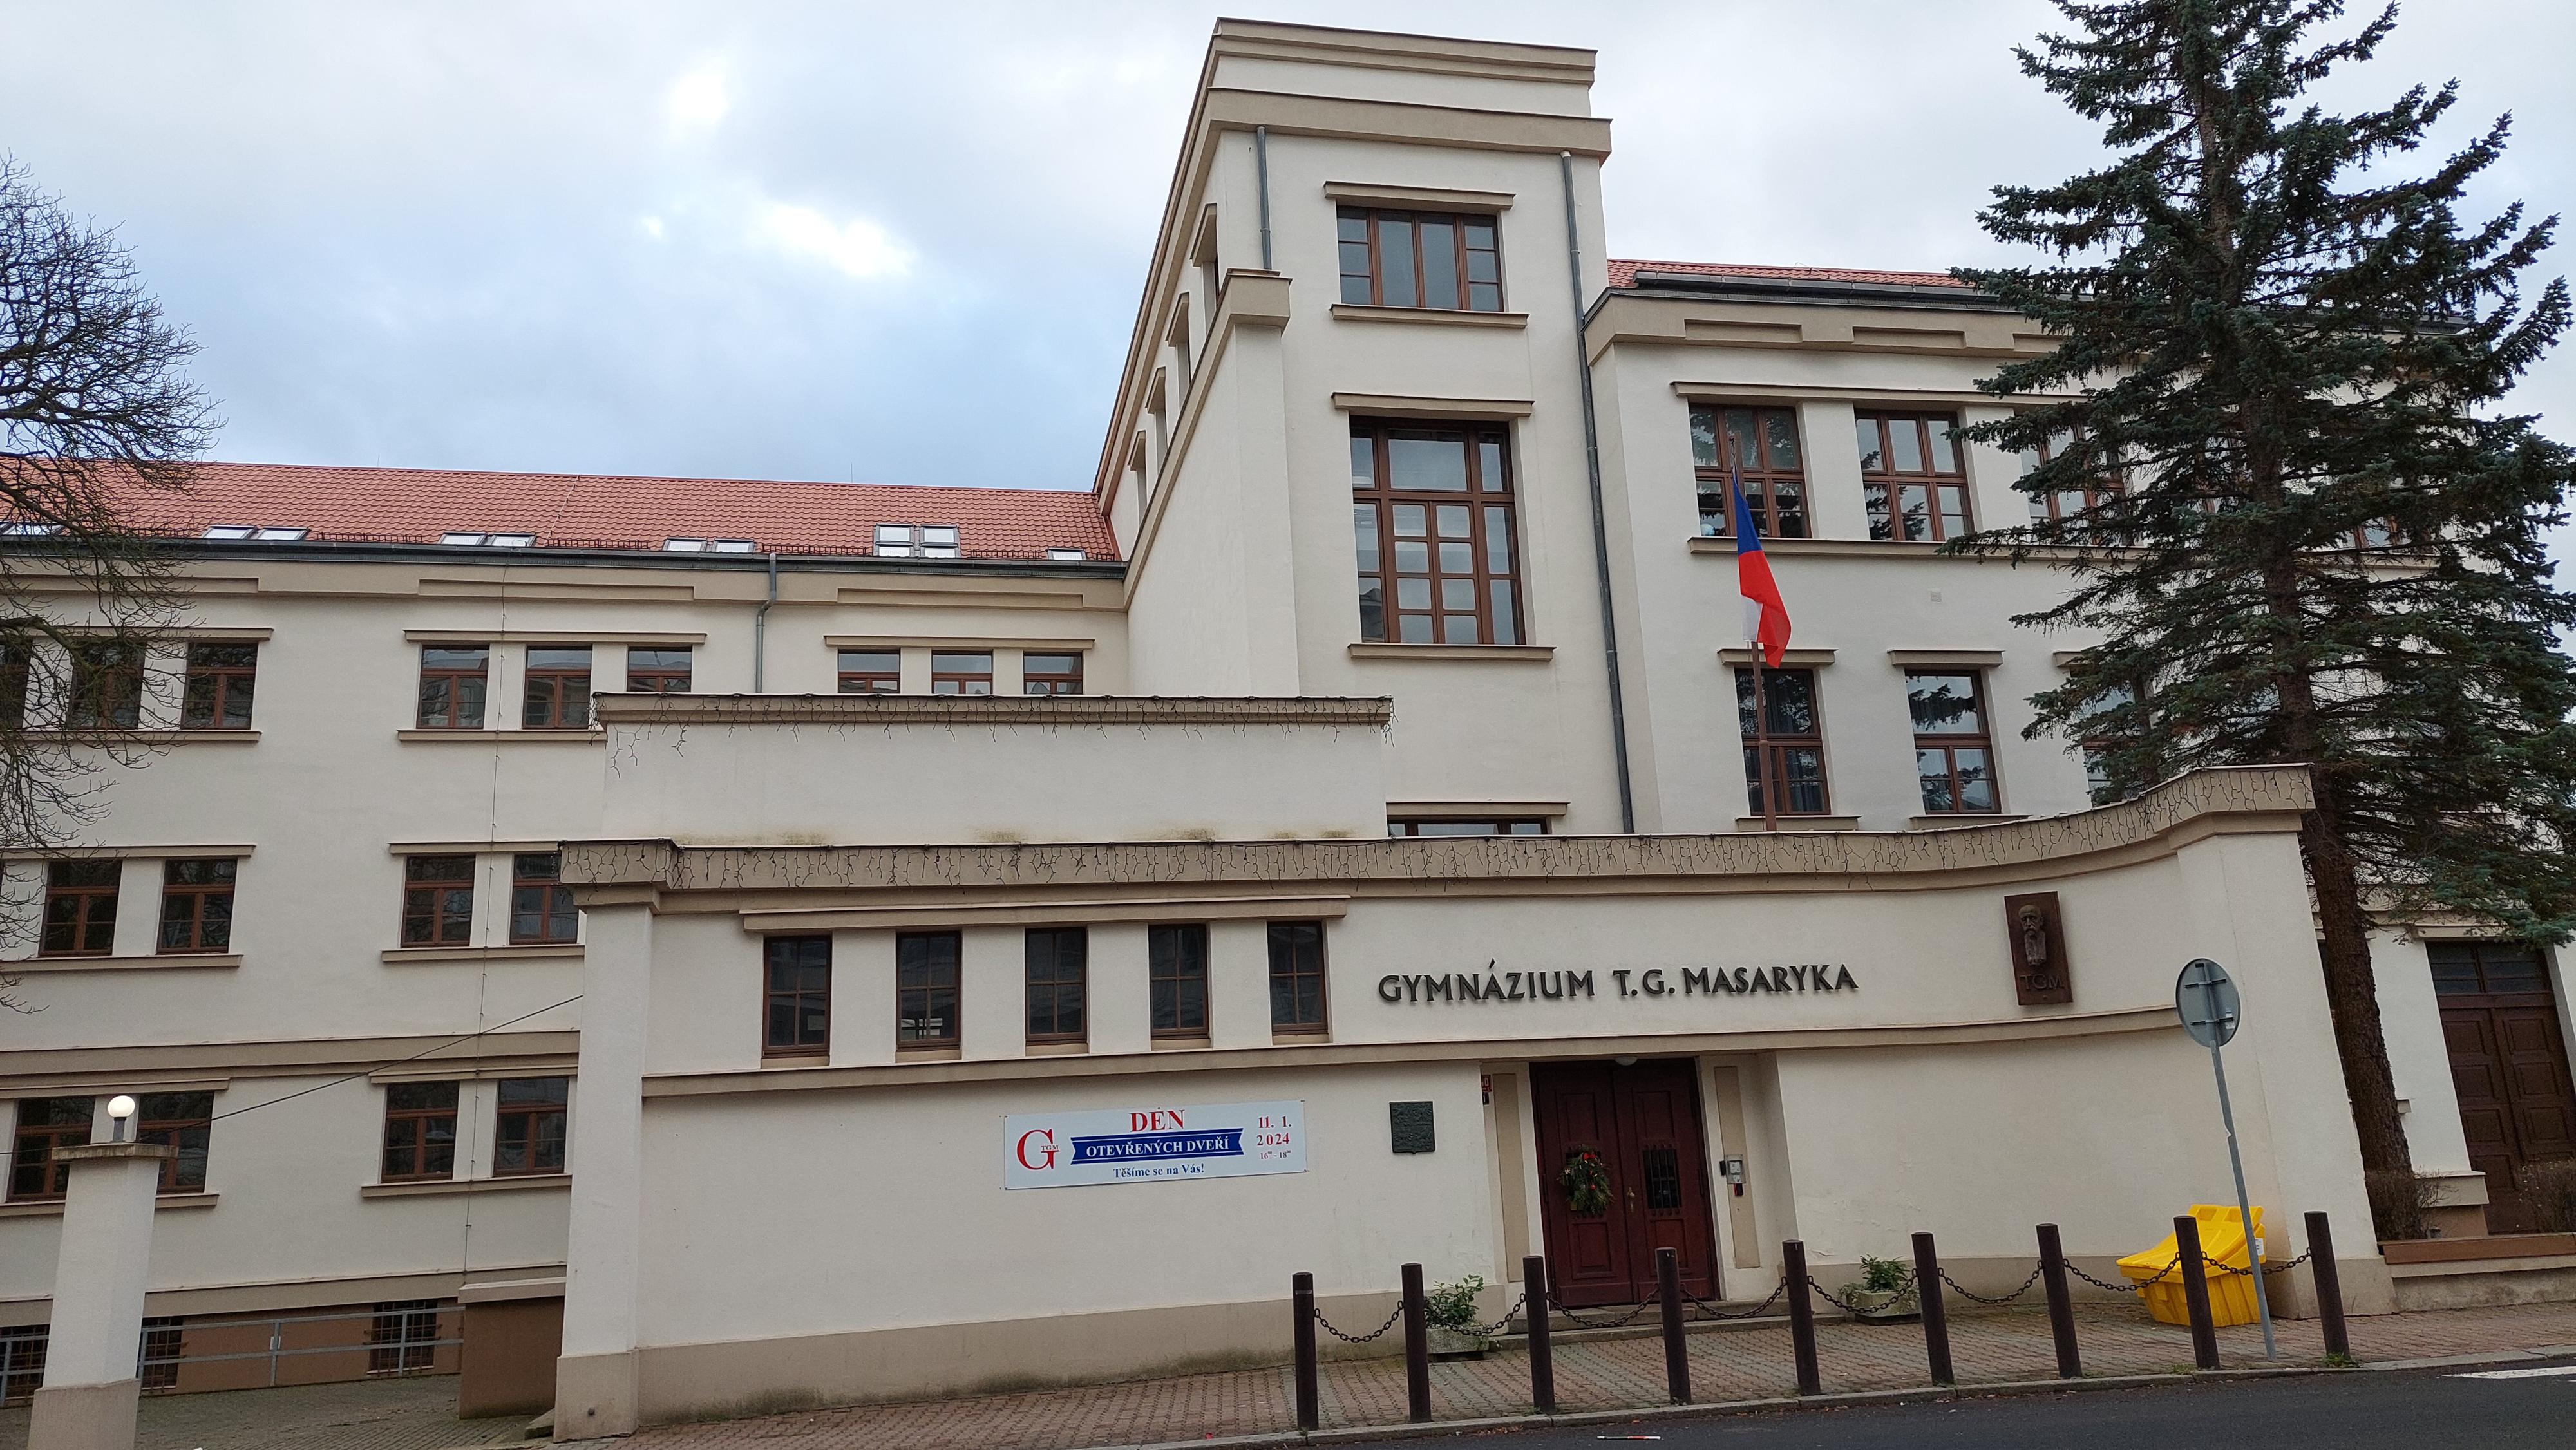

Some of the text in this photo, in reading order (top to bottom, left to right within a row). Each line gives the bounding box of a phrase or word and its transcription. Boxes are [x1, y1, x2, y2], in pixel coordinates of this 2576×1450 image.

[1378, 958, 1595, 1004] GYMNÁZIUM
[1681, 964, 1859, 996] MASARYKA
[2019, 973, 2063, 990] TGM
[1130, 1109, 1185, 1132] DEN
[1258, 1115, 1291, 1129] 11. 1.
[1017, 1128, 1059, 1170] G
[1086, 1136, 1229, 1157] OTEVŘENÝCH DVEŘÍ
[1113, 1167, 1150, 1178] Těšíme
[1166, 1167, 1179, 1175] na
[1181, 1163, 1205, 1174] Vás!
